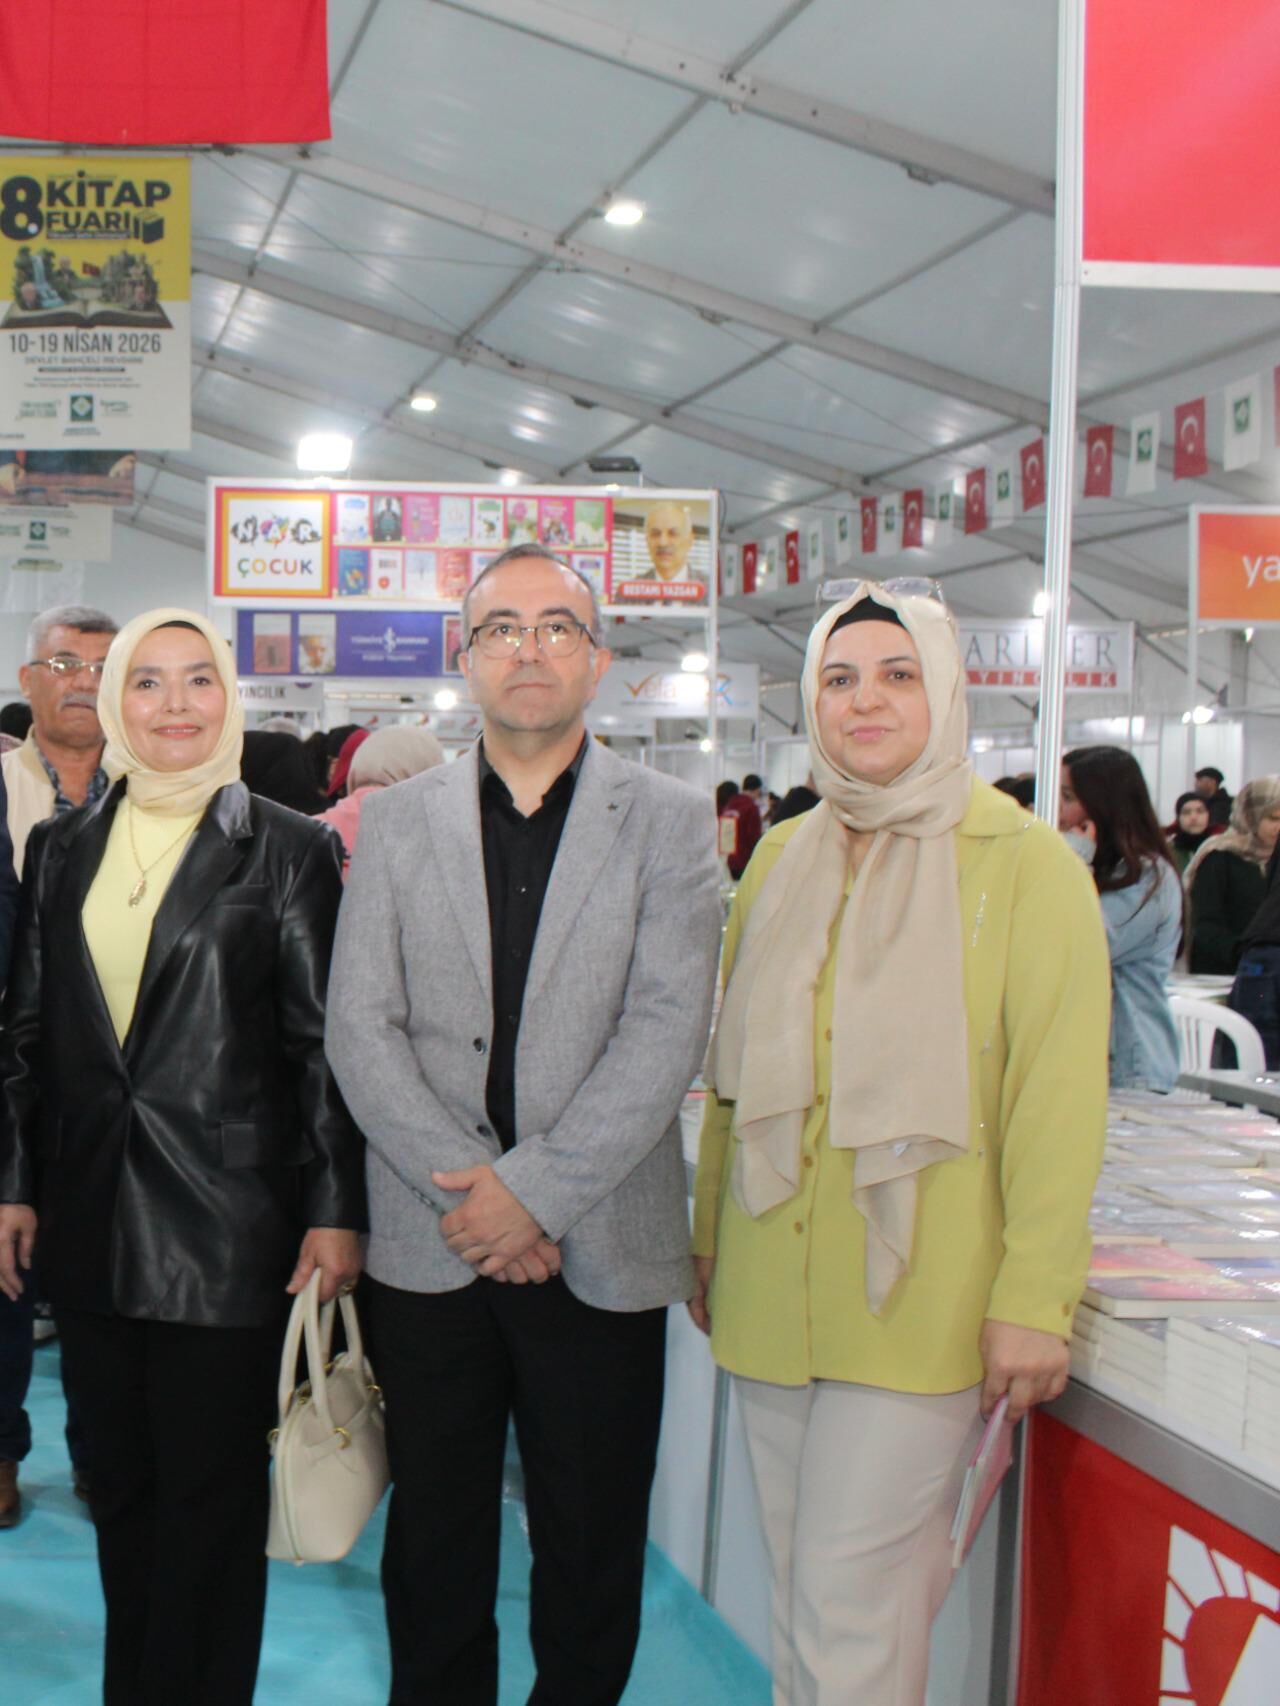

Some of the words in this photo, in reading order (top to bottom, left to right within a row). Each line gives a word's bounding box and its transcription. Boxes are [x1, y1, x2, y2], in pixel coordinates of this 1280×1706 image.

[46, 170, 172, 208] KİTAP
[46, 211, 130, 230] FUARI
[9, 334, 59, 353] 10-19
[63, 328, 113, 353] NİSAN
[118, 333, 161, 353] 2026
[237, 557, 314, 578] ÇOCUK
[1241, 554, 1280, 591] ya
